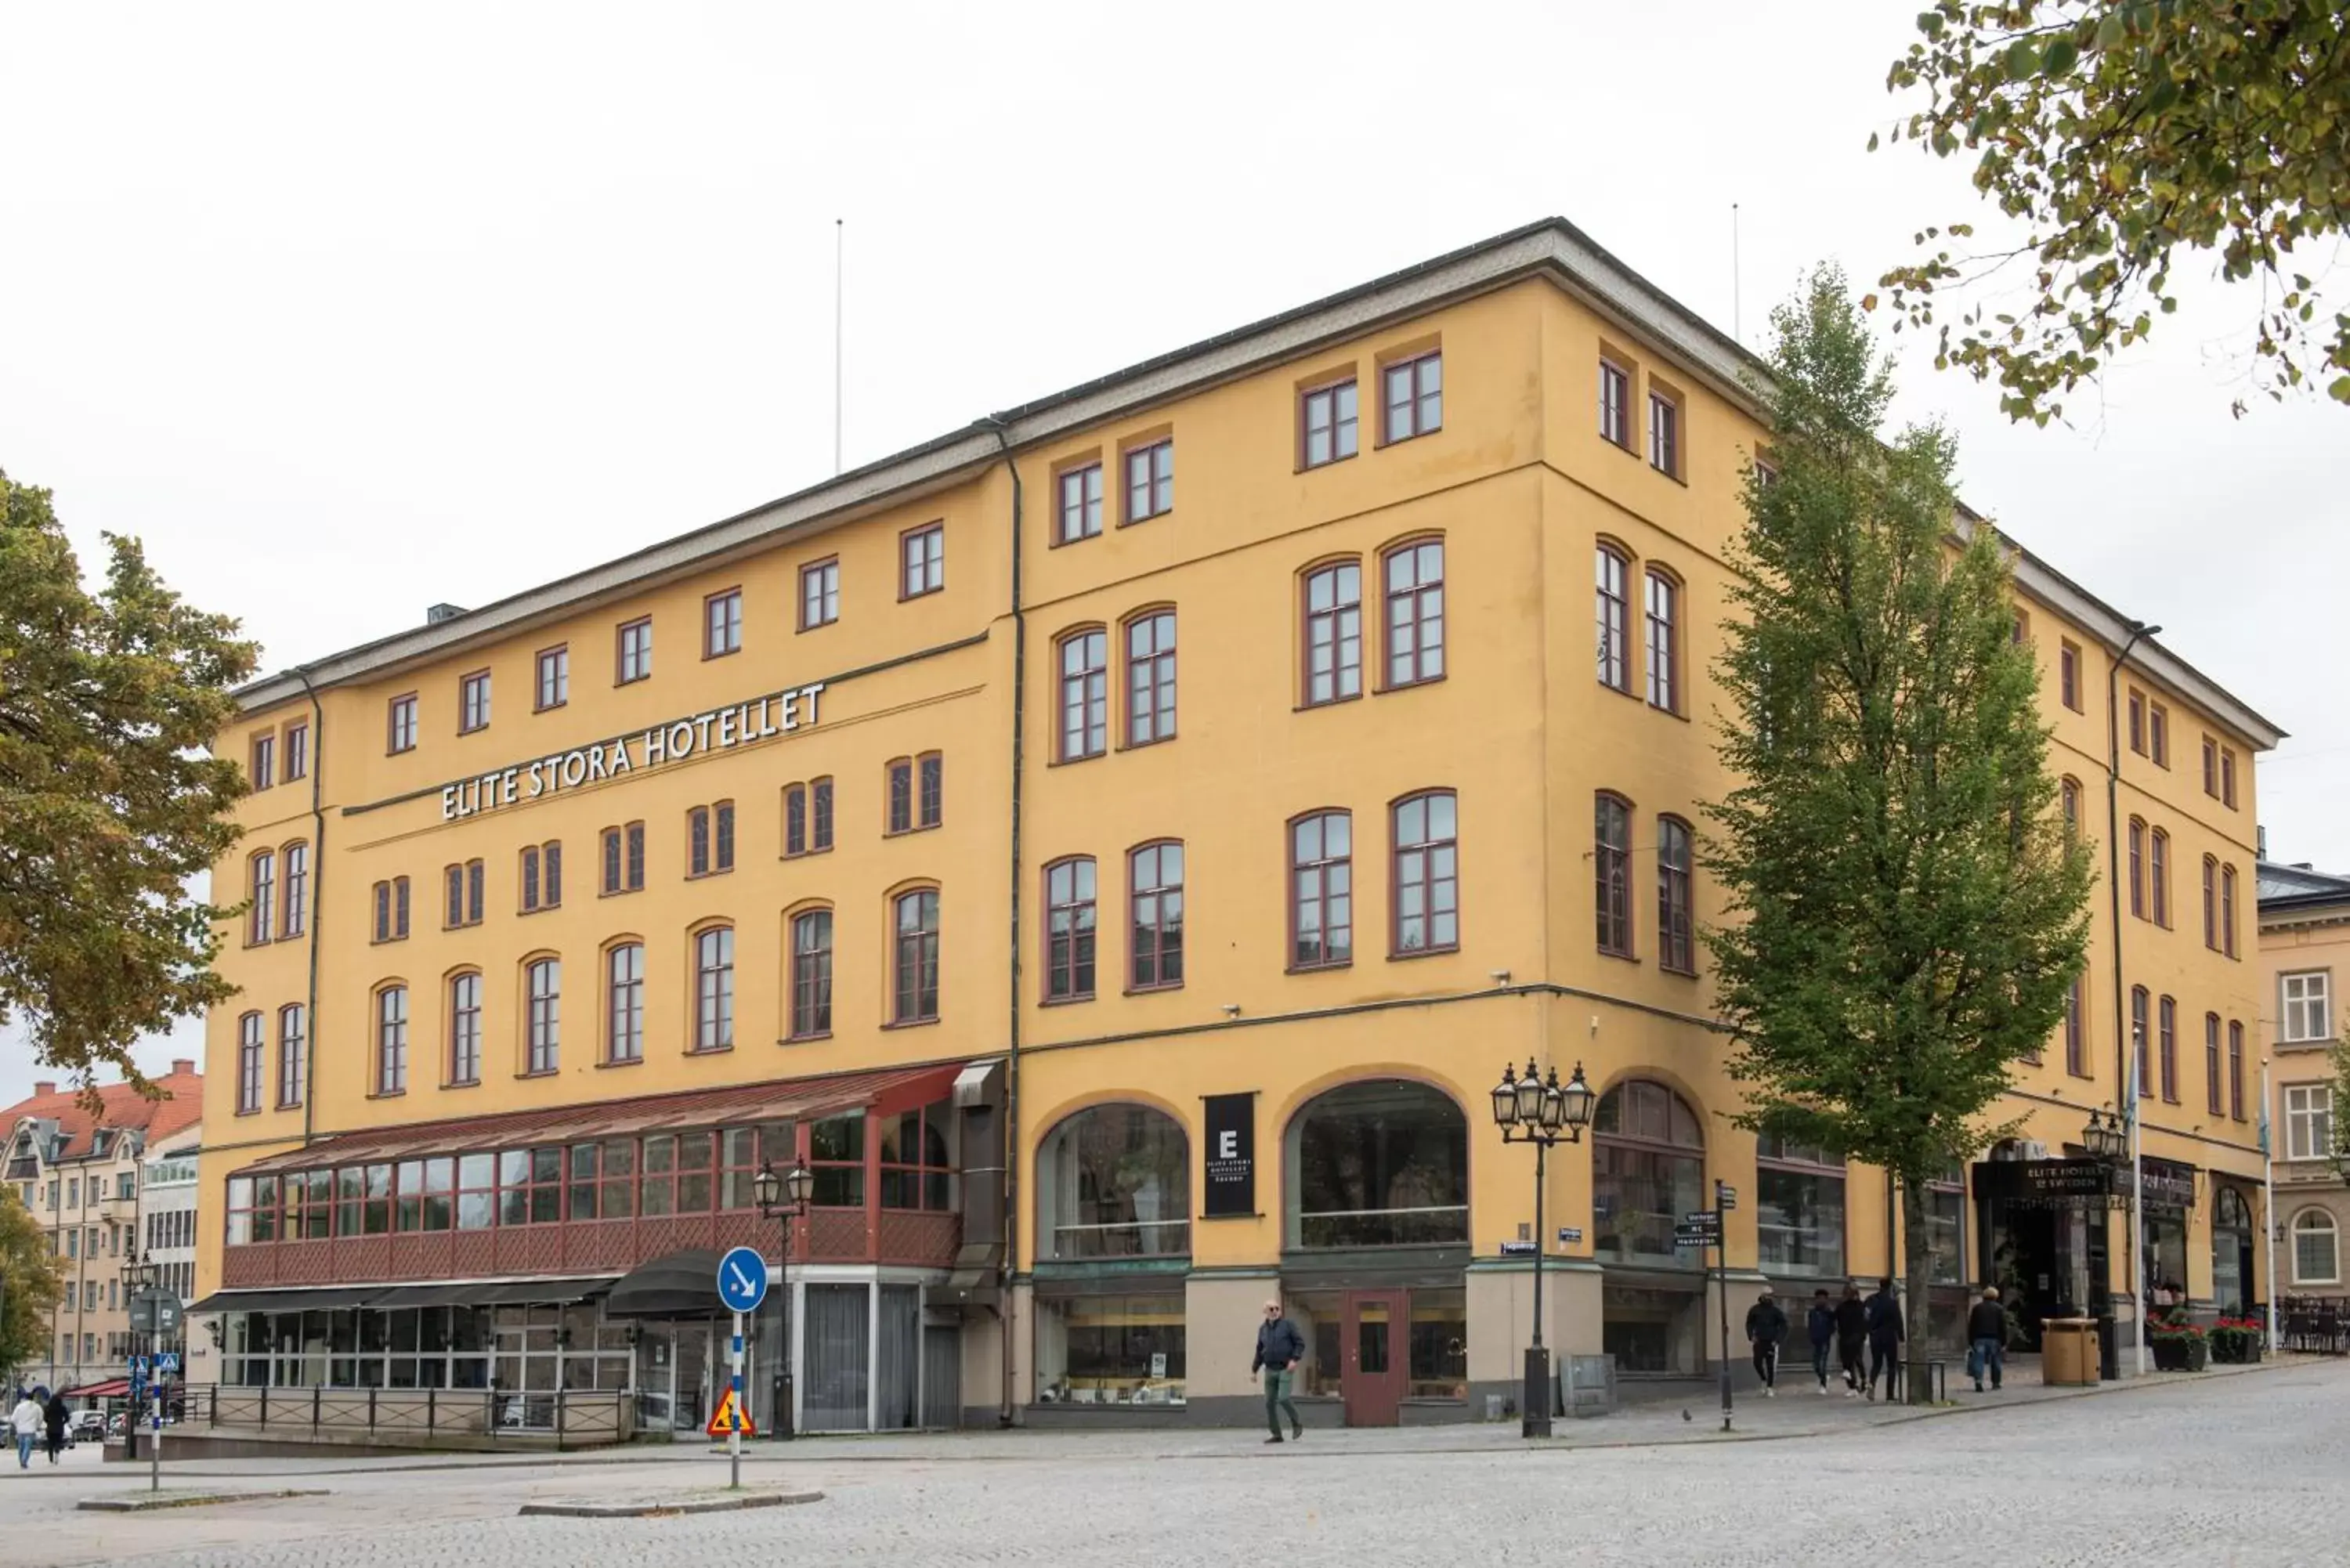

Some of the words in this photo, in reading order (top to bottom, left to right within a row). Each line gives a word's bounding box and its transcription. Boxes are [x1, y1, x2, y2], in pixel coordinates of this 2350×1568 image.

[443, 768, 518, 819] ELITE
[529, 739, 631, 797] STORA
[645, 683, 824, 766] HOTELLET
[1220, 1130, 1237, 1158] E
[2028, 1168, 2056, 1177] ELITE
[2048, 1178, 2097, 1188] SWEDEN
